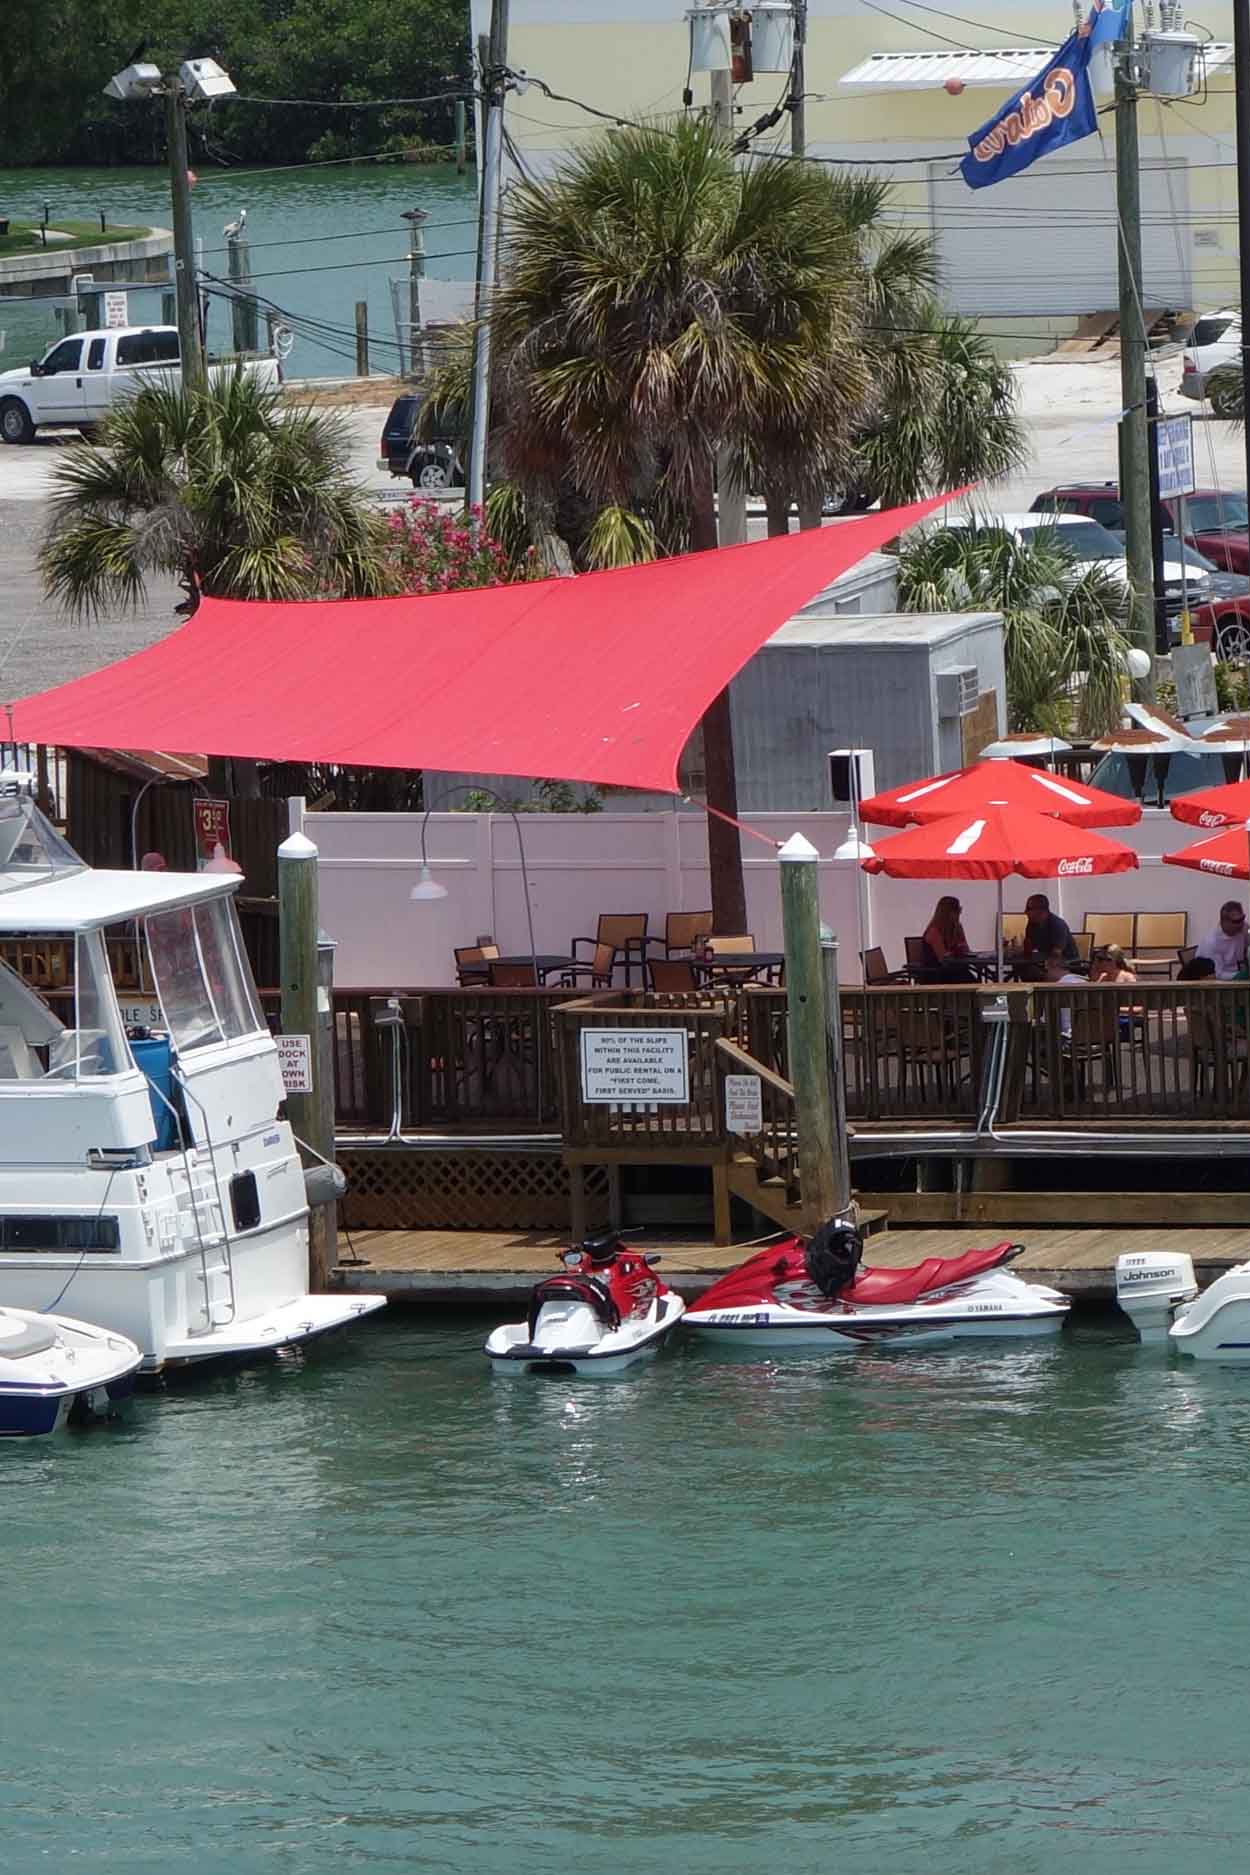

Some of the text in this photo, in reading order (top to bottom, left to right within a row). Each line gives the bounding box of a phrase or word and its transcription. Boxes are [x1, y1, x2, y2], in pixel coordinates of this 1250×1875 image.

[1058, 856, 1094, 875] Coca-Cola
[282, 1039, 304, 1048] USE
[278, 1050, 306, 1058] DOCK
[287, 1060, 298, 1068] AT
[281, 1070, 305, 1078] OWN
[284, 1080, 306, 1088] RISK
[1123, 1269, 1176, 1281] Johnson
[974, 1304, 1004, 1313] YAMAHA
